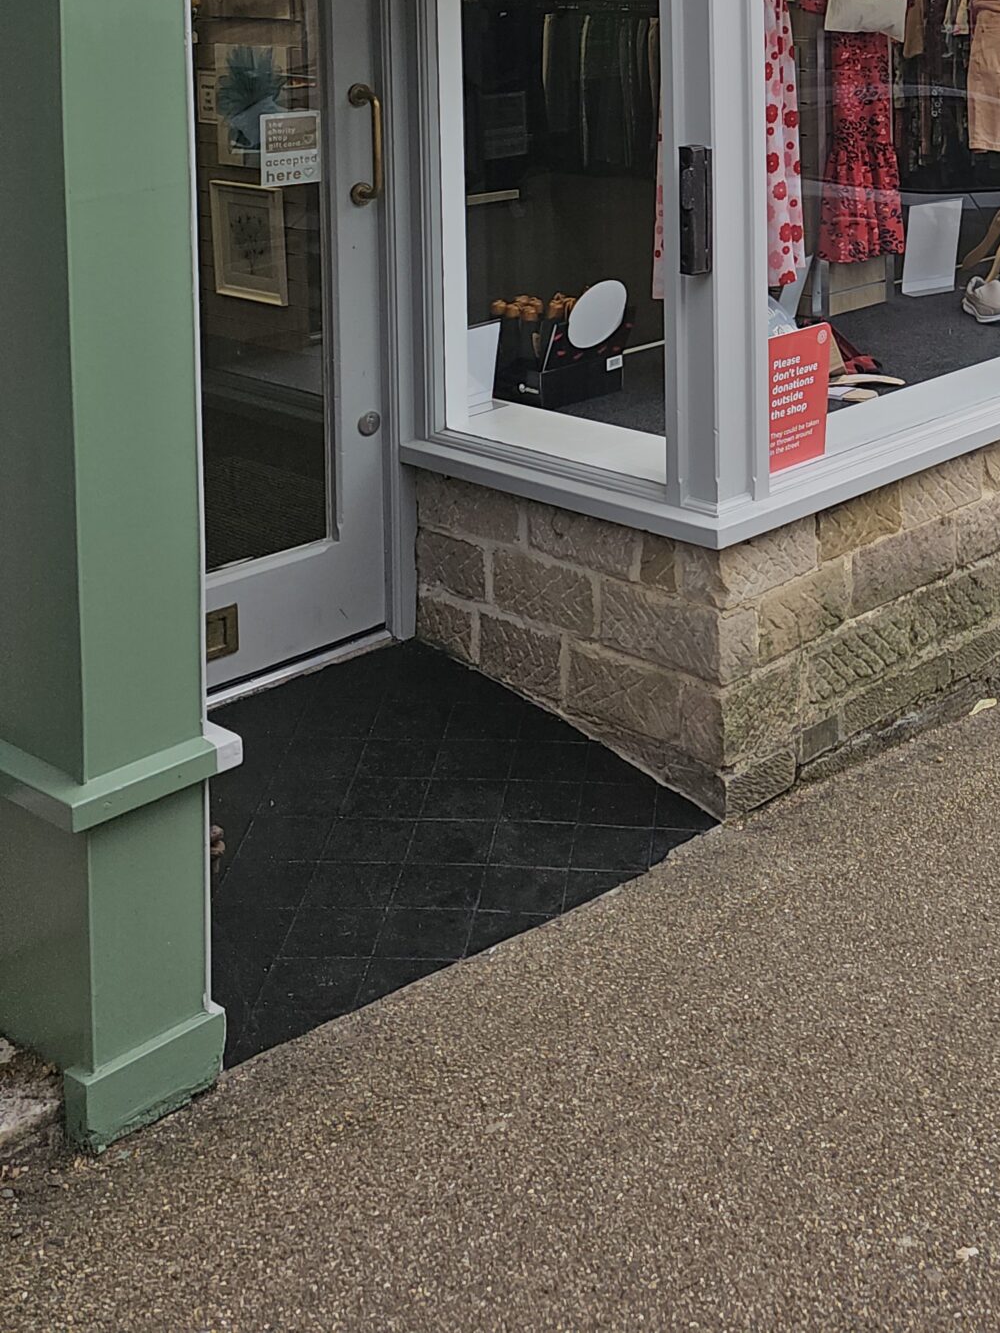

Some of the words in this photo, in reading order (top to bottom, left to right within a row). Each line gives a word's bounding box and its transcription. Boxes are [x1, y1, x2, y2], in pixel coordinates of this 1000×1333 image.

[283, 140, 301, 148] card
[265, 154, 317, 167] accepted
[266, 170, 301, 182] here
[773, 356, 800, 370] Please
[773, 368, 795, 382] don't
[796, 362, 818, 376] leave
[772, 376, 814, 395] donations
[771, 390, 803, 407] outside
[771, 409, 785, 420] the
[786, 403, 807, 415] shop
[770, 431, 784, 439] They
[784, 425, 797, 435] could
[805, 419, 819, 428] taken
[776, 435, 795, 446] thrown
[795, 428, 813, 439] around
[785, 441, 800, 451] street
